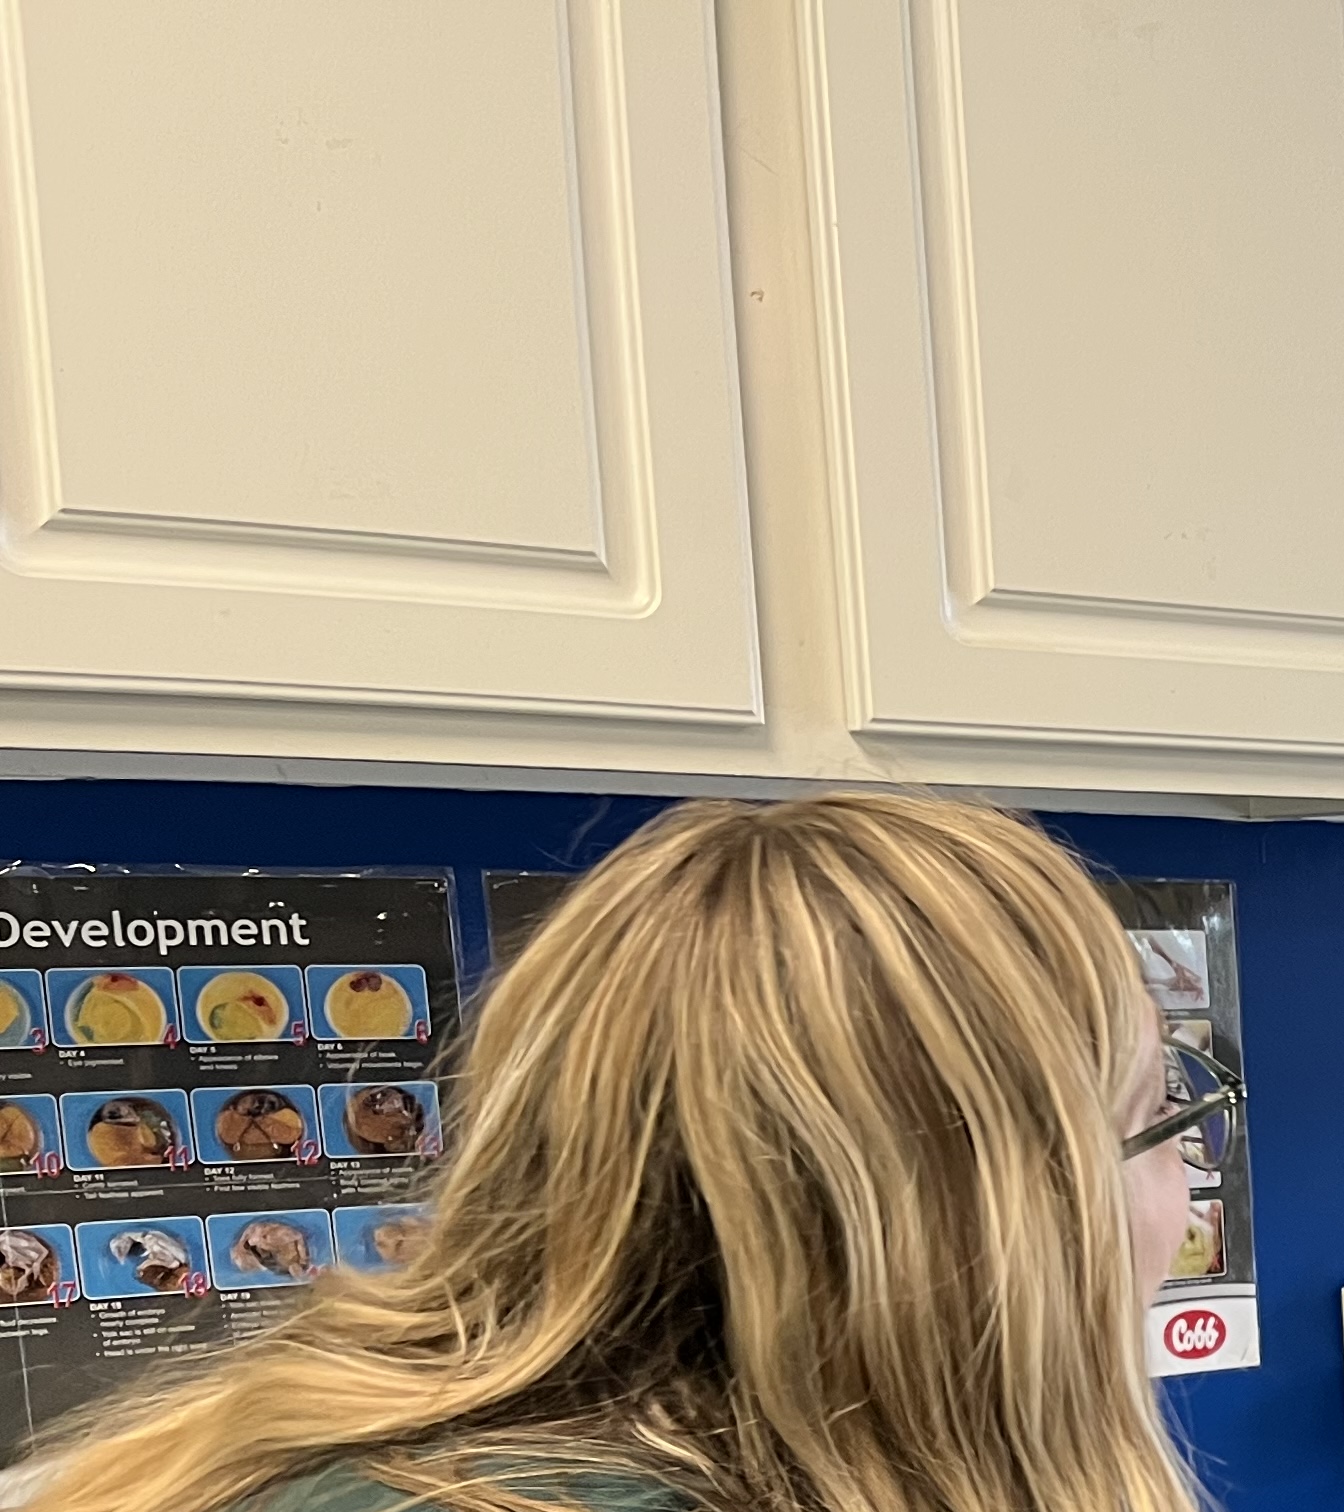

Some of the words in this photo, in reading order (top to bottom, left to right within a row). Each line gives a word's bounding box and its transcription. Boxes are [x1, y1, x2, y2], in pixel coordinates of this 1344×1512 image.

[0, 909, 310, 956] Development
[29, 1151, 60, 1179] 10
[164, 1145, 189, 1172] 11
[291, 1139, 319, 1167] 12
[47, 1280, 76, 1309] 17
[178, 1271, 208, 1299] 18
[1172, 1316, 1219, 1353] Cobb
